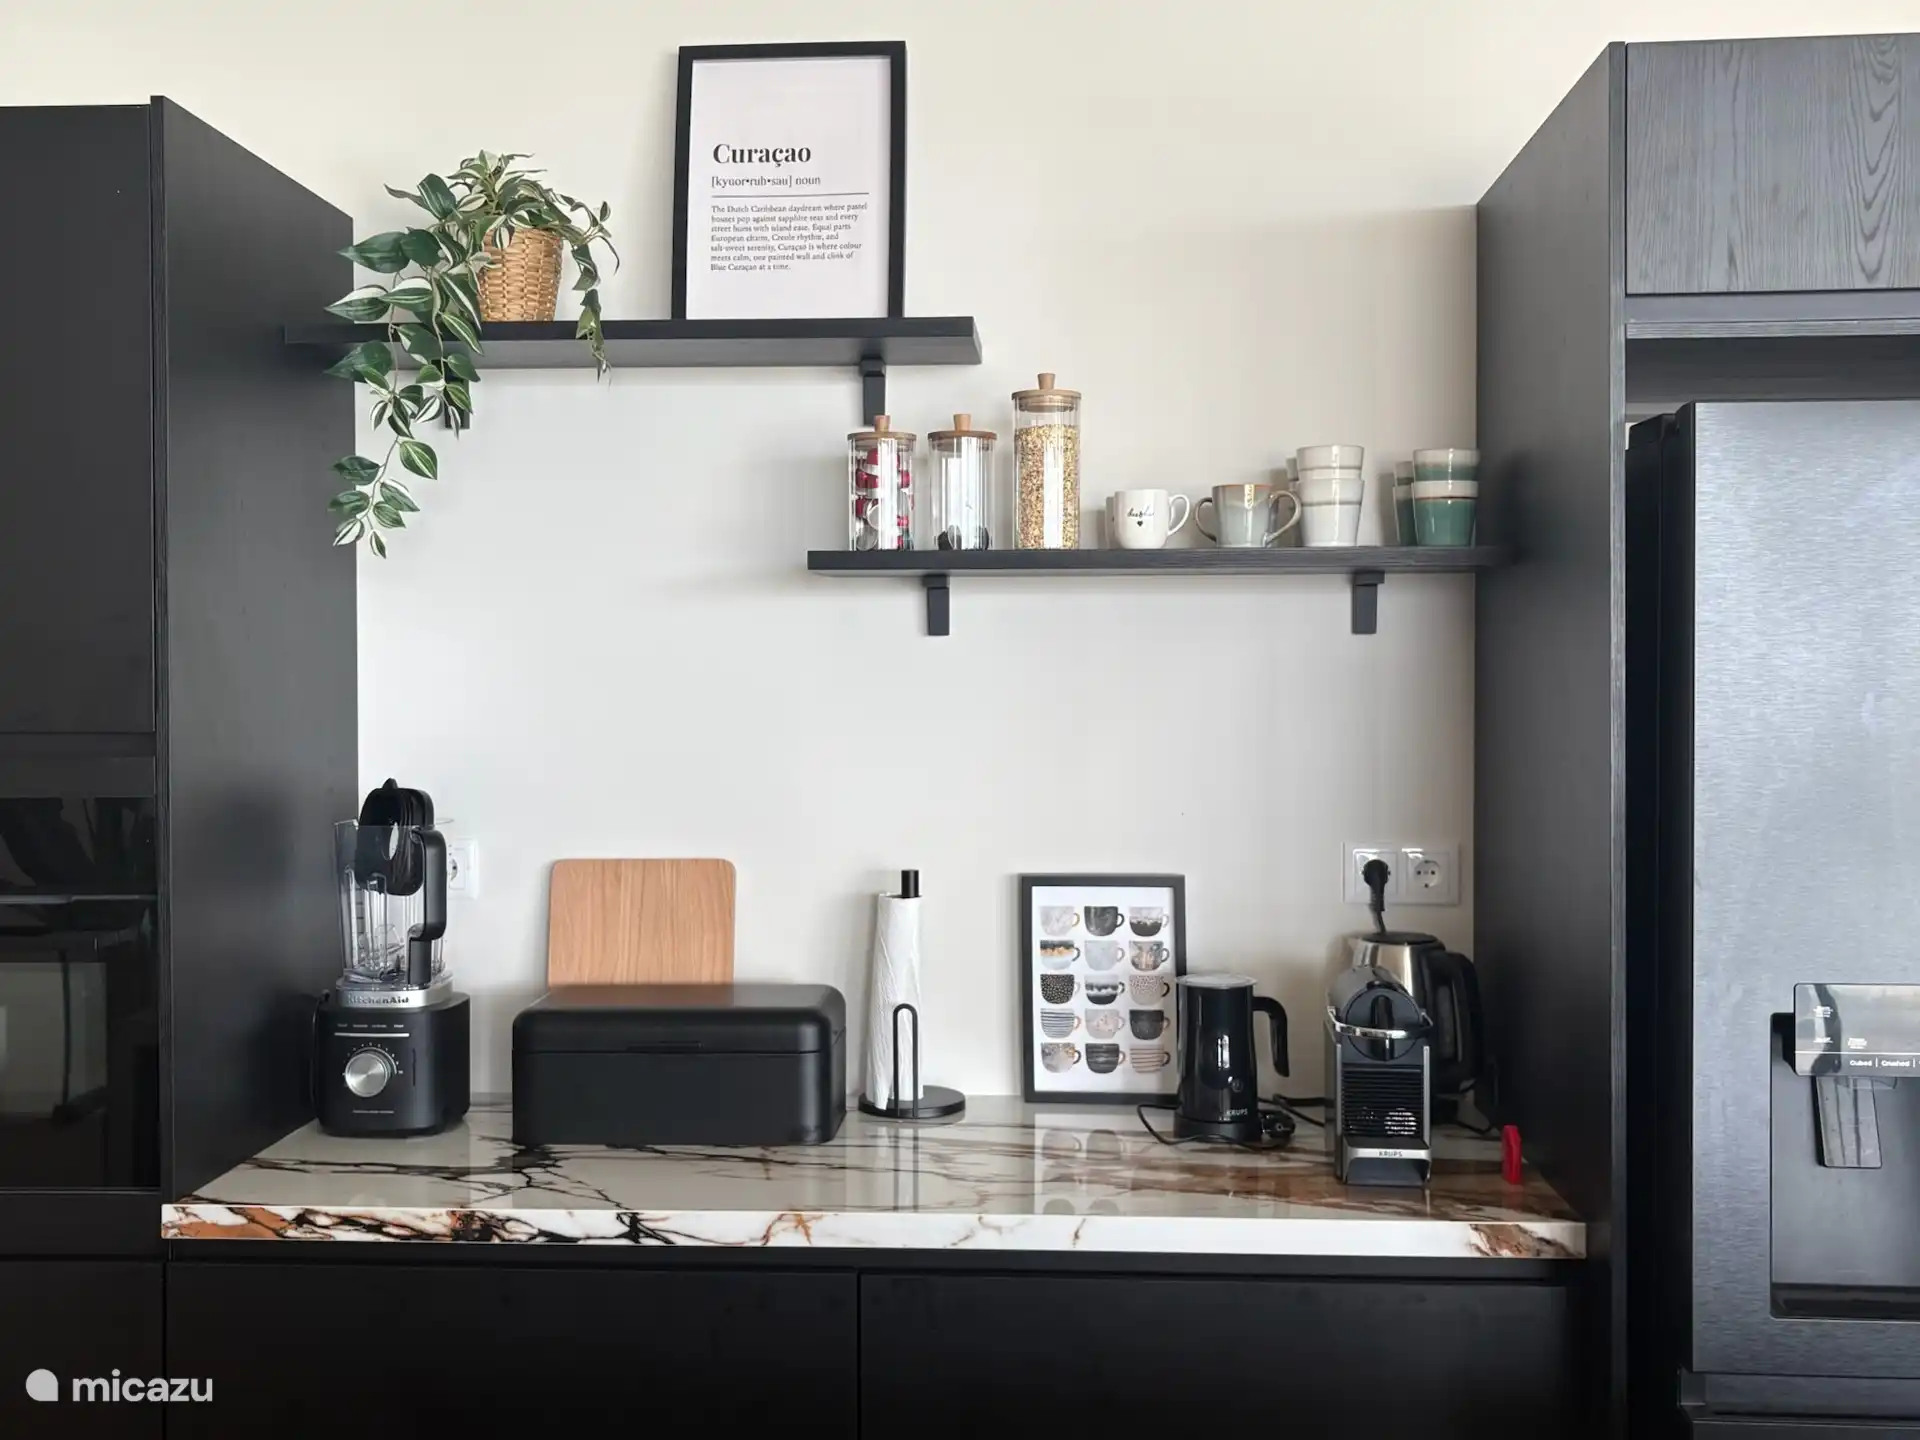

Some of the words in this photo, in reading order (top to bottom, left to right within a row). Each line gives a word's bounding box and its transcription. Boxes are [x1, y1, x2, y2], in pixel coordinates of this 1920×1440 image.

[713, 144, 811, 168] Curaçao
[795, 176, 821, 186] noun
[711, 205, 725, 213] The
[727, 205, 749, 213] Dutch
[751, 204, 787, 213] Caribbean
[788, 204, 822, 214] daydream
[846, 202, 868, 212] pastel
[711, 215, 735, 223] houses
[736, 216, 751, 224] pop
[752, 215, 777, 224] against
[778, 214, 808, 224] sapphire
[825, 213, 838, 221] and
[839, 213, 859, 222] every
[733, 224, 752, 232] hums
[753, 224, 769, 232] with
[770, 224, 792, 232] island
[812, 223, 832, 232] Equal
[833, 223, 852, 232] parts
[711, 234, 745, 243] European
[771, 233, 796, 241] Creole
[825, 232, 839, 240] and
[777, 243, 807, 252] Curaçao
[816, 242, 838, 250] where
[839, 241, 862, 249] colour
[768, 252, 795, 262] painted
[796, 251, 811, 260] wall
[812, 252, 825, 260] and
[845, 250, 854, 259] of
[710, 263, 727, 271] Blue
[728, 263, 757, 272] Curaçao
